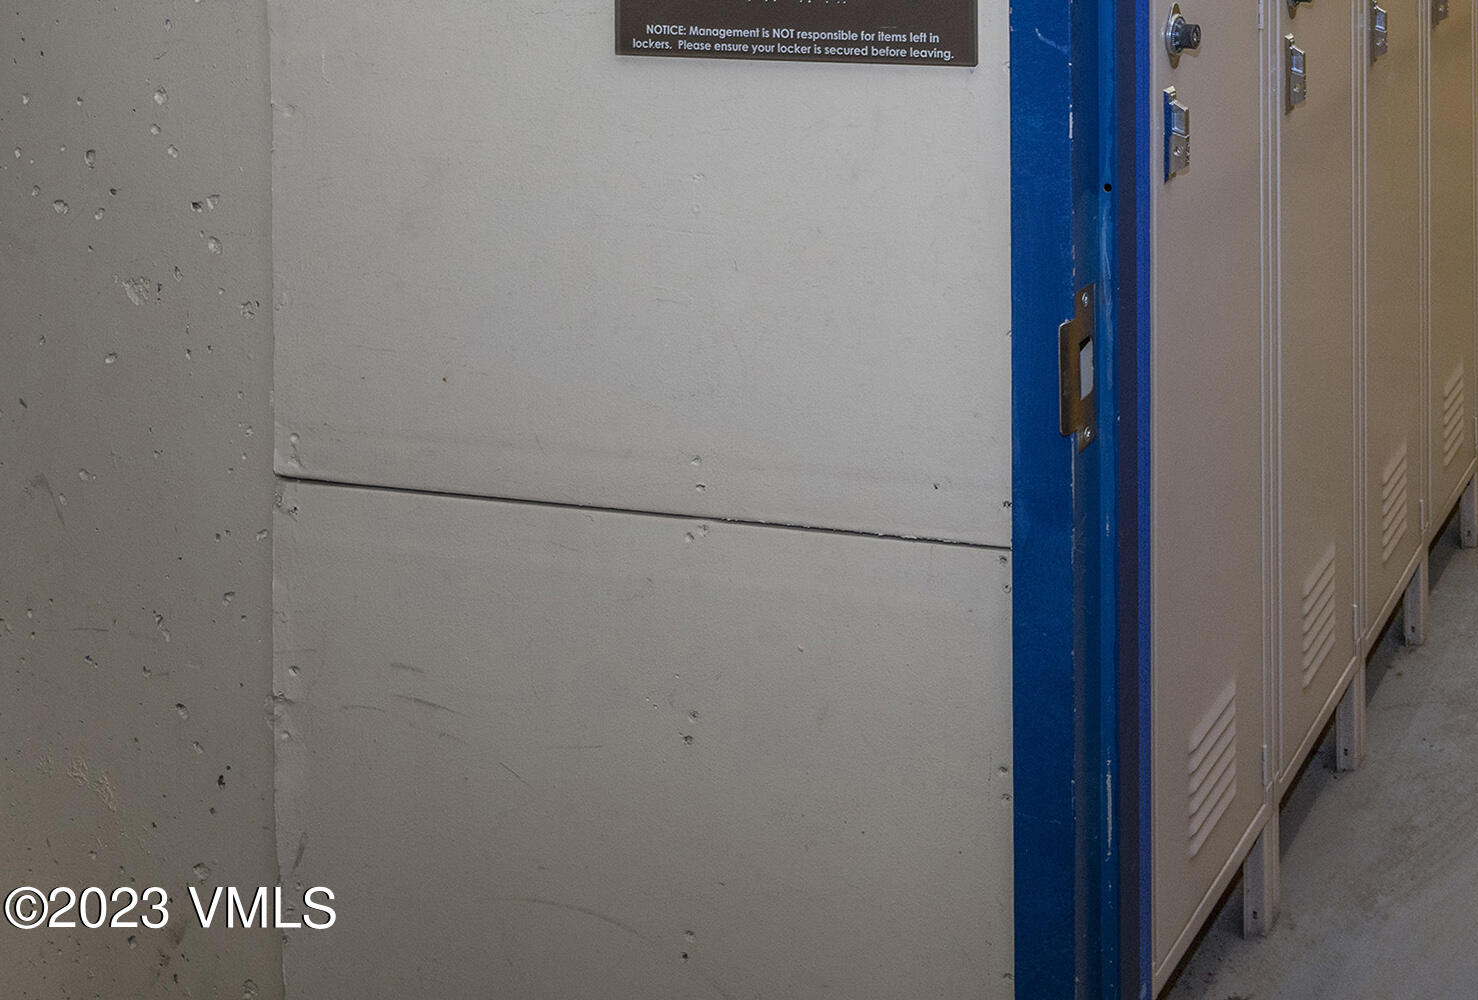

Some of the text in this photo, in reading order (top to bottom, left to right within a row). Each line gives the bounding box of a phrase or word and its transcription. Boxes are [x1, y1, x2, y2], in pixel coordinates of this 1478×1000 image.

[646, 24, 940, 43] NOTICE: Management is NOT responsible for items left in
[632, 38, 955, 61] lockers. Please ensure your locker is secured before leaving.
